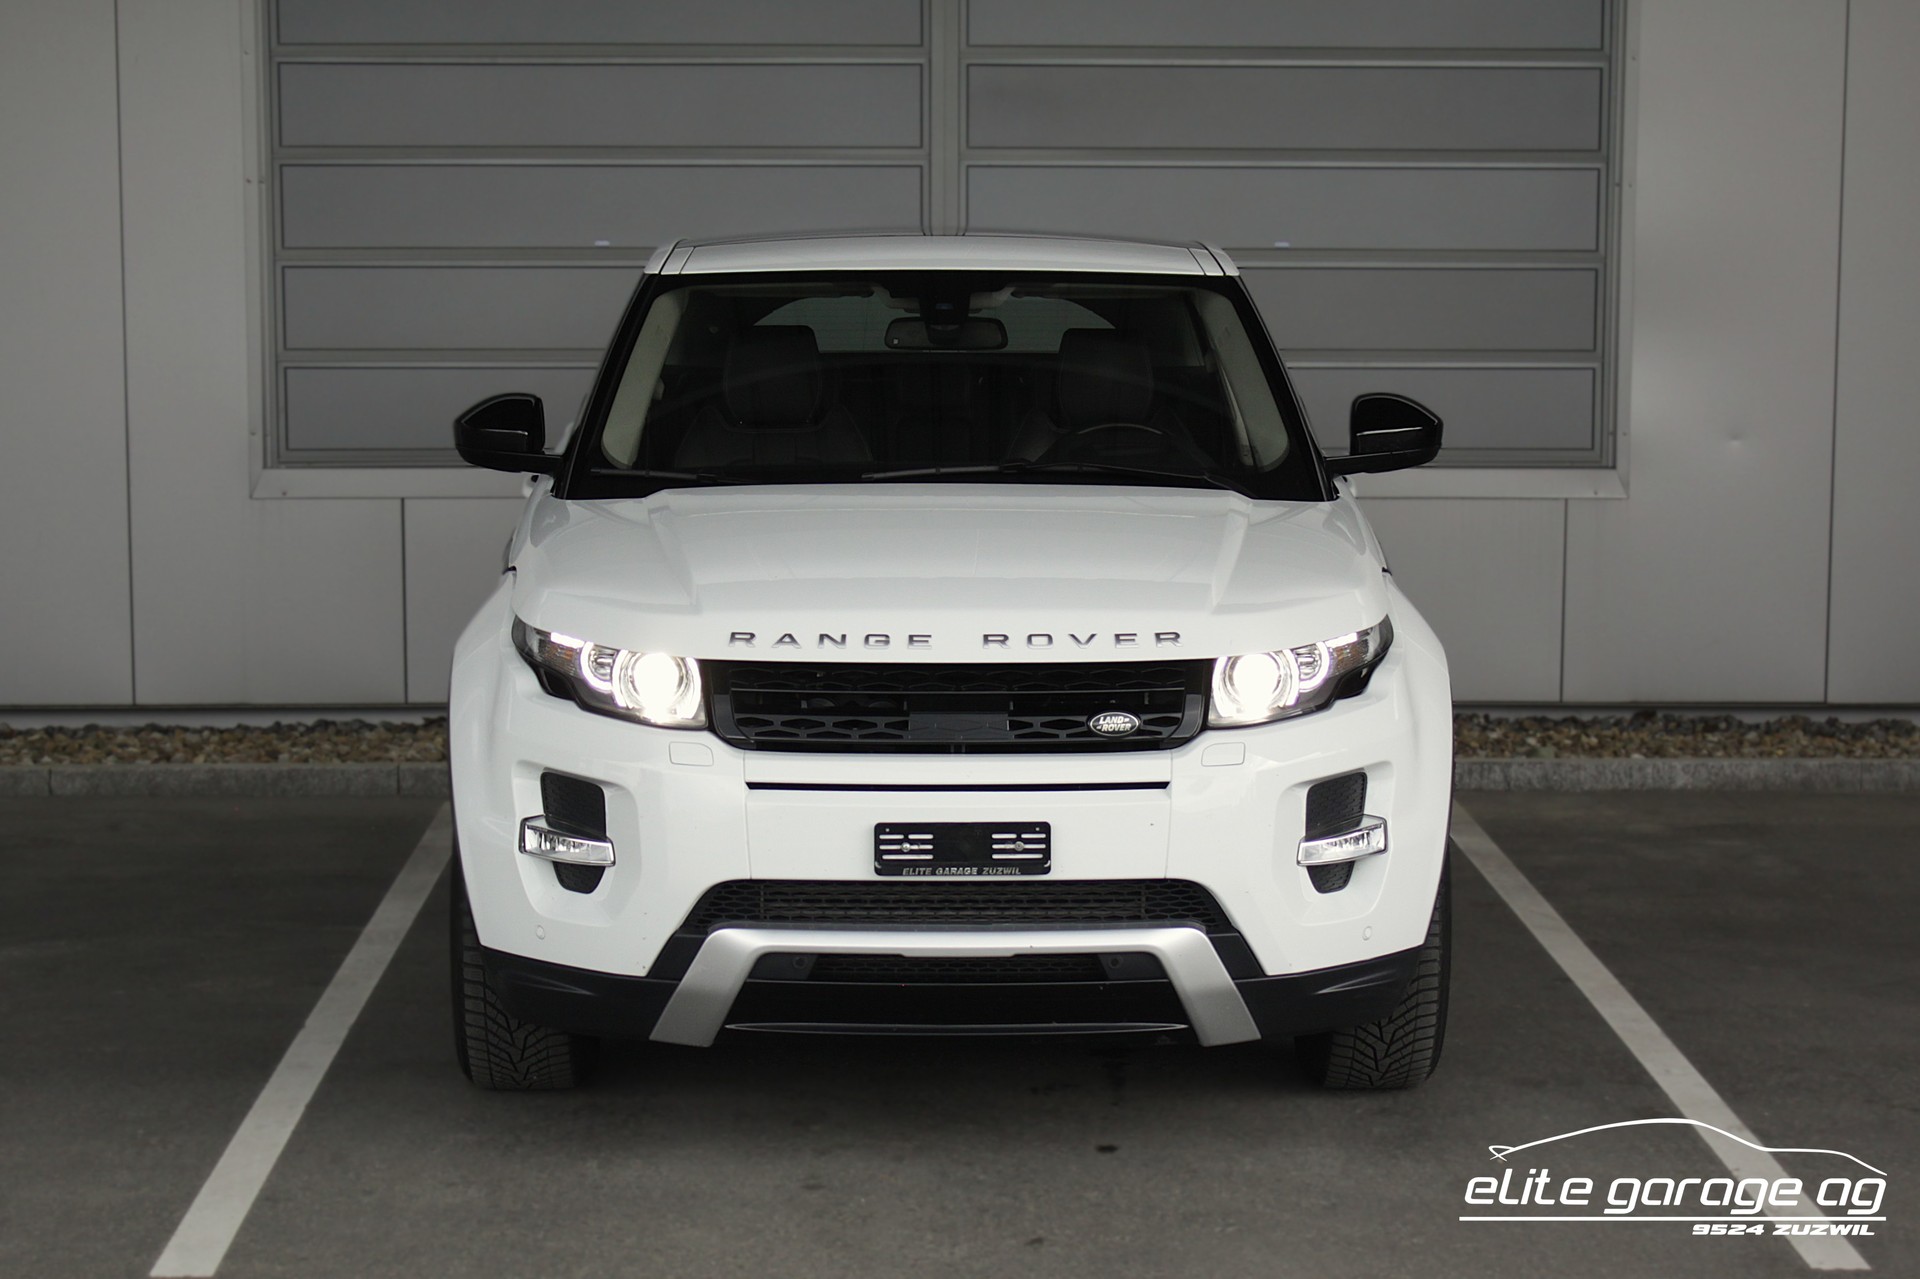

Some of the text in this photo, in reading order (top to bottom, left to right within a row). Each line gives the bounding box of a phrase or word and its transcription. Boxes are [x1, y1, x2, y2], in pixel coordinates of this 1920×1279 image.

[728, 631, 1183, 650] RANGE ROVER
[1099, 716, 1124, 724] LAND
[1101, 723, 1131, 731] ROVER
[902, 866, 1022, 876] ELITE GARAGE ZUZWIL
